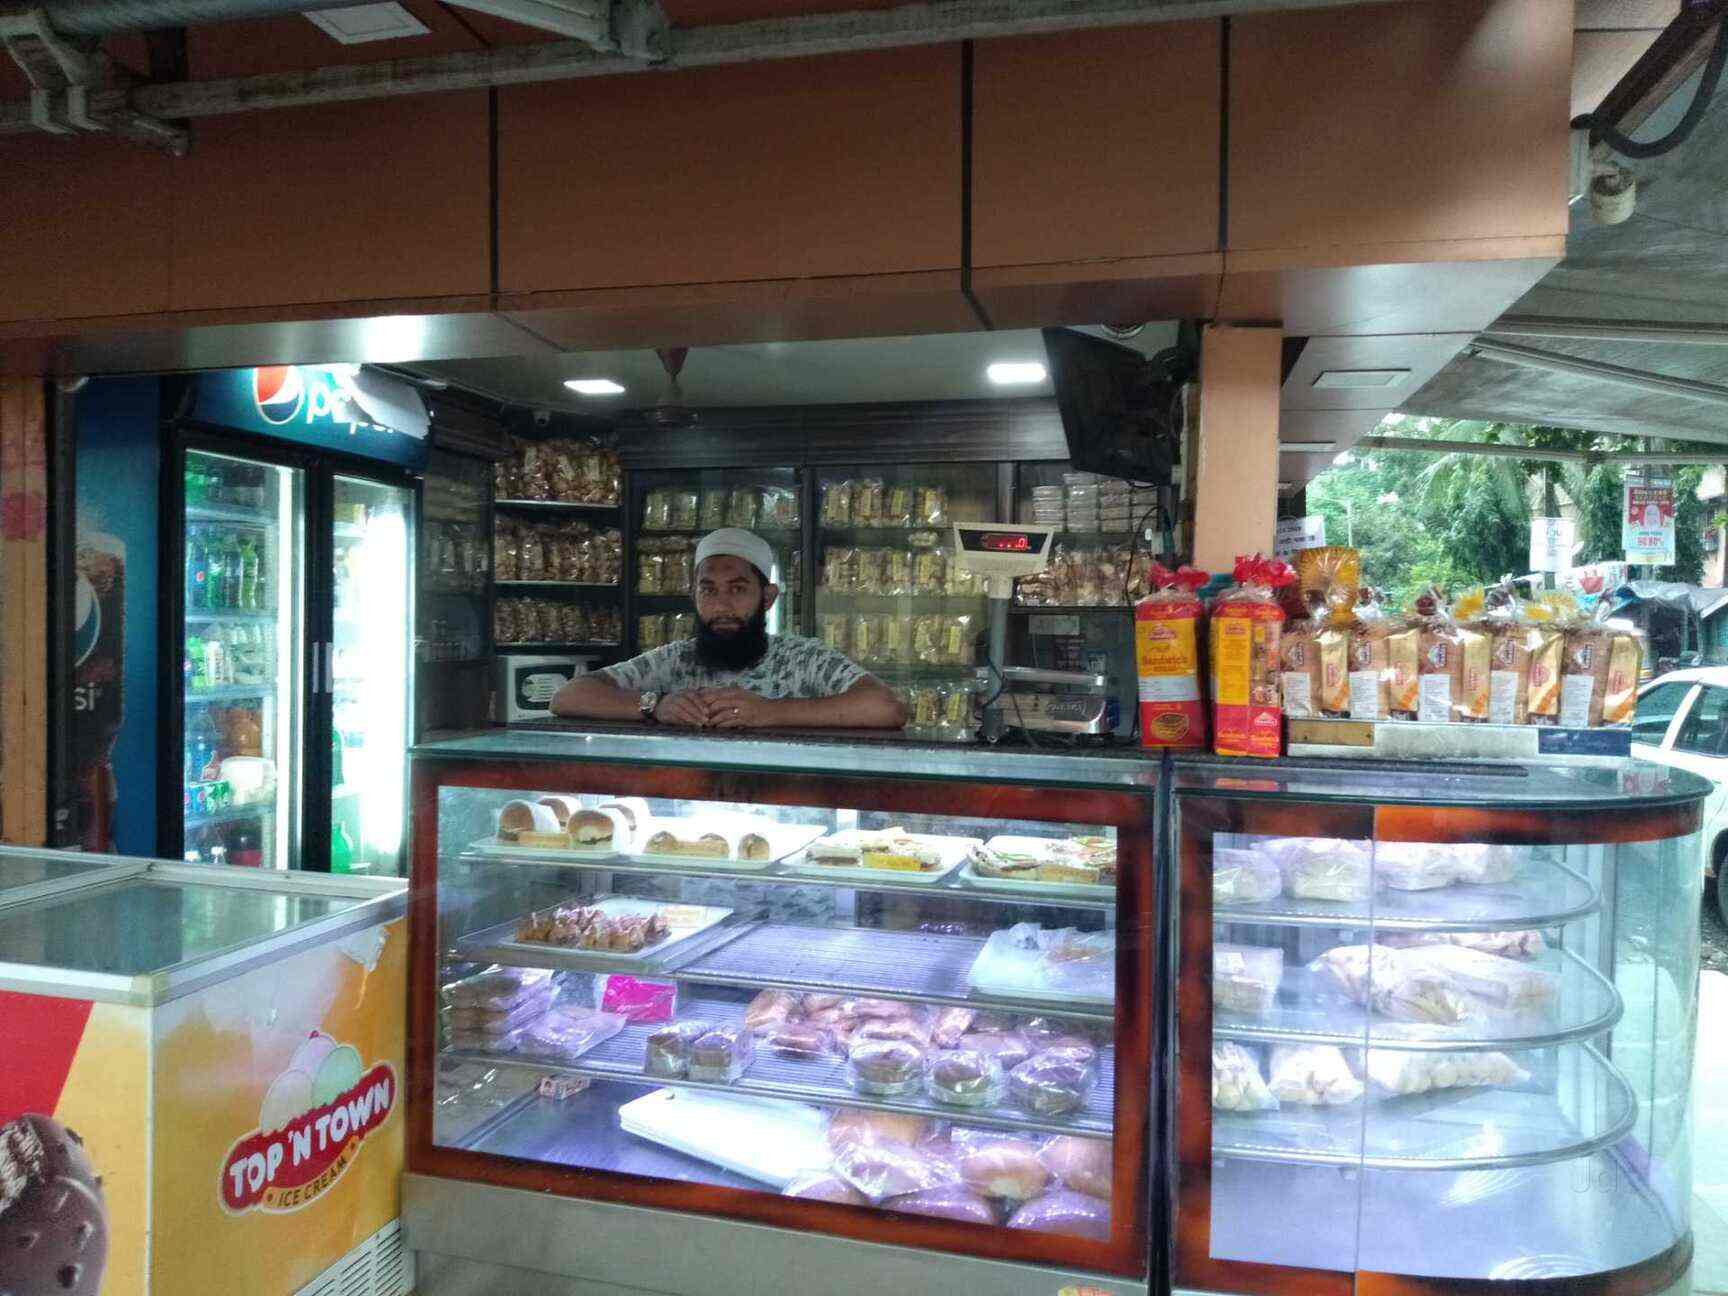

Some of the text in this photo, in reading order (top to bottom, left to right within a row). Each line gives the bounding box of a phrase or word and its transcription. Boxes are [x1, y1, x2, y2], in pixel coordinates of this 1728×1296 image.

[229, 1142, 284, 1198] TOP
[315, 1077, 390, 1151] TOWN
[277, 1156, 348, 1207] ICE CREAM
